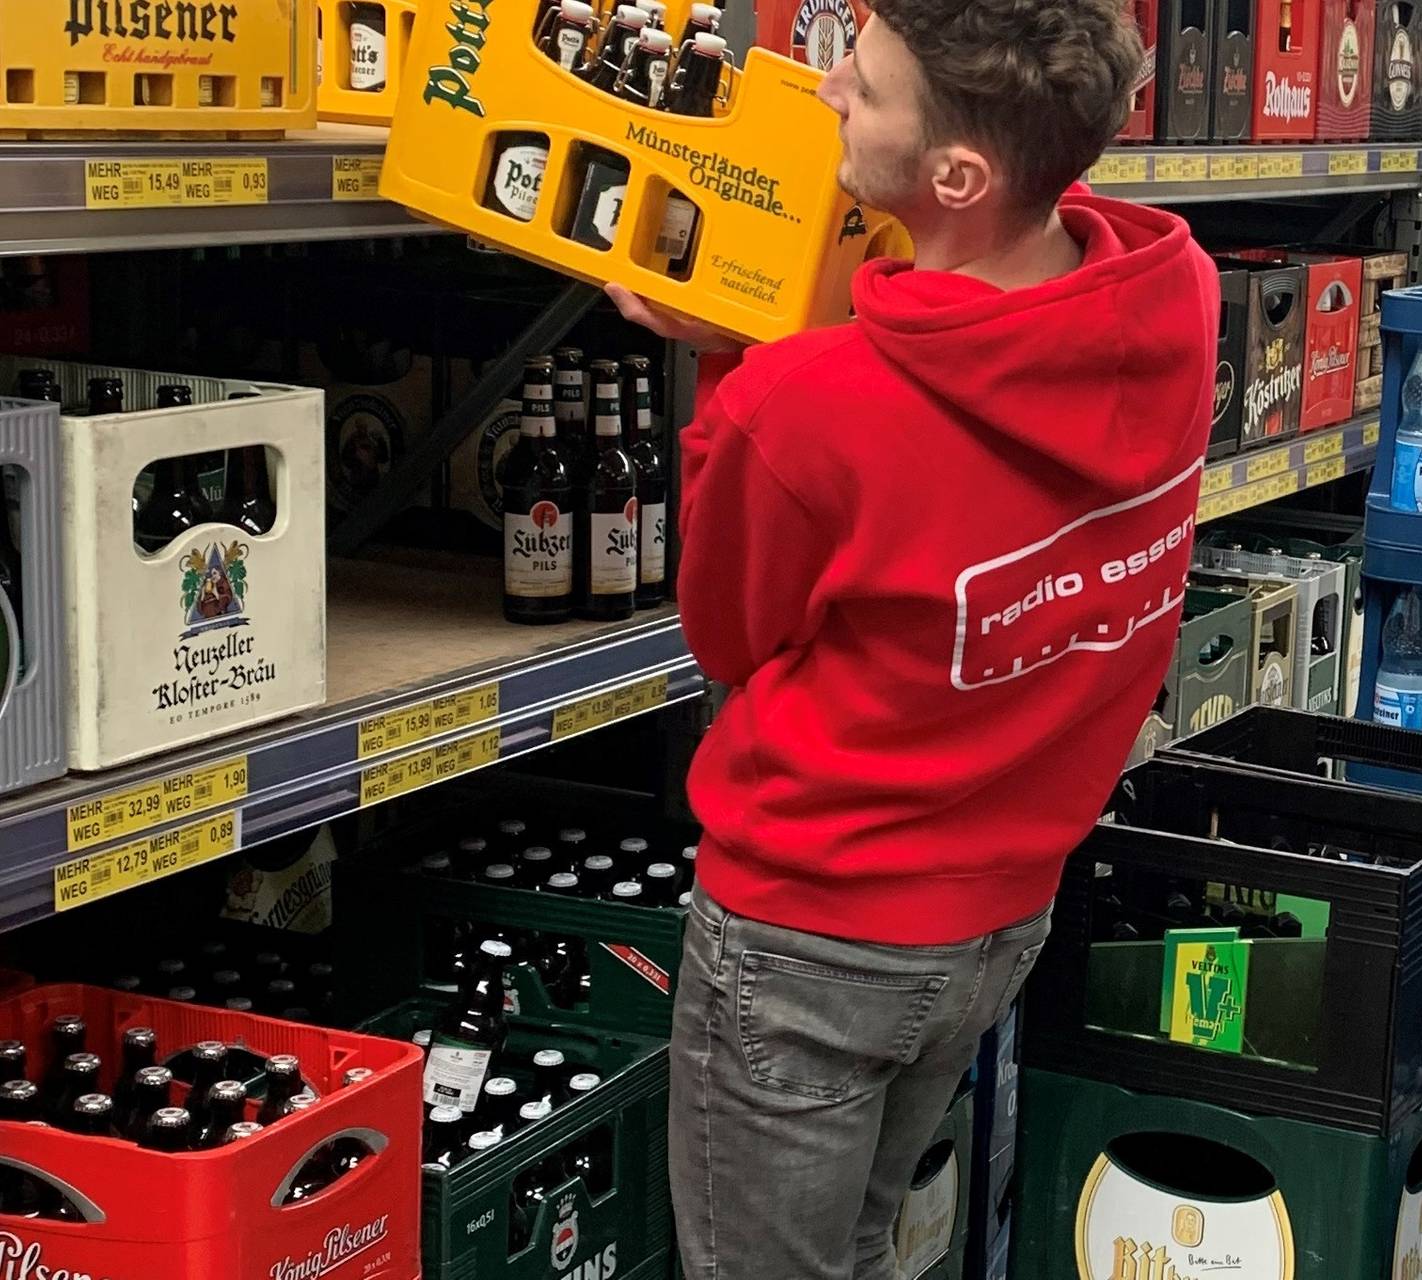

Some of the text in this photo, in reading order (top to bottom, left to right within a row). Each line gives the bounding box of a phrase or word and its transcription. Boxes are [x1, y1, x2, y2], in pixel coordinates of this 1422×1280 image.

[423, 0, 495, 118] Pott
[1264, 70, 1311, 124] Rothaus
[335, 158, 361, 172] MEHR
[625, 121, 781, 193] Münsterländer
[89, 163, 121, 177] MEHR
[183, 162, 213, 176] MEHR
[505, 160, 543, 191] Pot
[149, 174, 180, 191] 15,49
[186, 184, 210, 198] WEG
[243, 173, 266, 191] 0,93
[337, 178, 359, 192] WEG
[92, 185, 119, 200] WEG
[533, 559, 557, 571] PILS
[980, 514, 1194, 636] radio essen
[173, 632, 255, 675] Neuzeller
[433, 694, 457, 710] MEHR
[360, 716, 386, 734] MEHR
[405, 713, 430, 733] 15,99
[435, 713, 454, 728] WEG
[363, 735, 383, 753] WEG
[482, 736, 499, 753] 1,12
[363, 763, 389, 781] MEHR
[408, 756, 432, 777] 13,99
[436, 759, 456, 775] WEG
[163, 774, 194, 795] MEHR
[224, 768, 246, 789] 1,90
[365, 782, 385, 800] WEG
[69, 801, 103, 822] MEHR
[128, 794, 160, 818] 32,99
[166, 795, 191, 814] WEG
[73, 823, 100, 842] WEG
[210, 820, 233, 842] 0,89
[150, 831, 180, 854] MEHR
[56, 859, 90, 881] MEHR
[116, 850, 148, 874] 12,79
[152, 852, 177, 873] WEG
[60, 880, 88, 903] WEG
[1191, 960, 1230, 975] VELTINS
[320, 1213, 389, 1269] Pilsener
